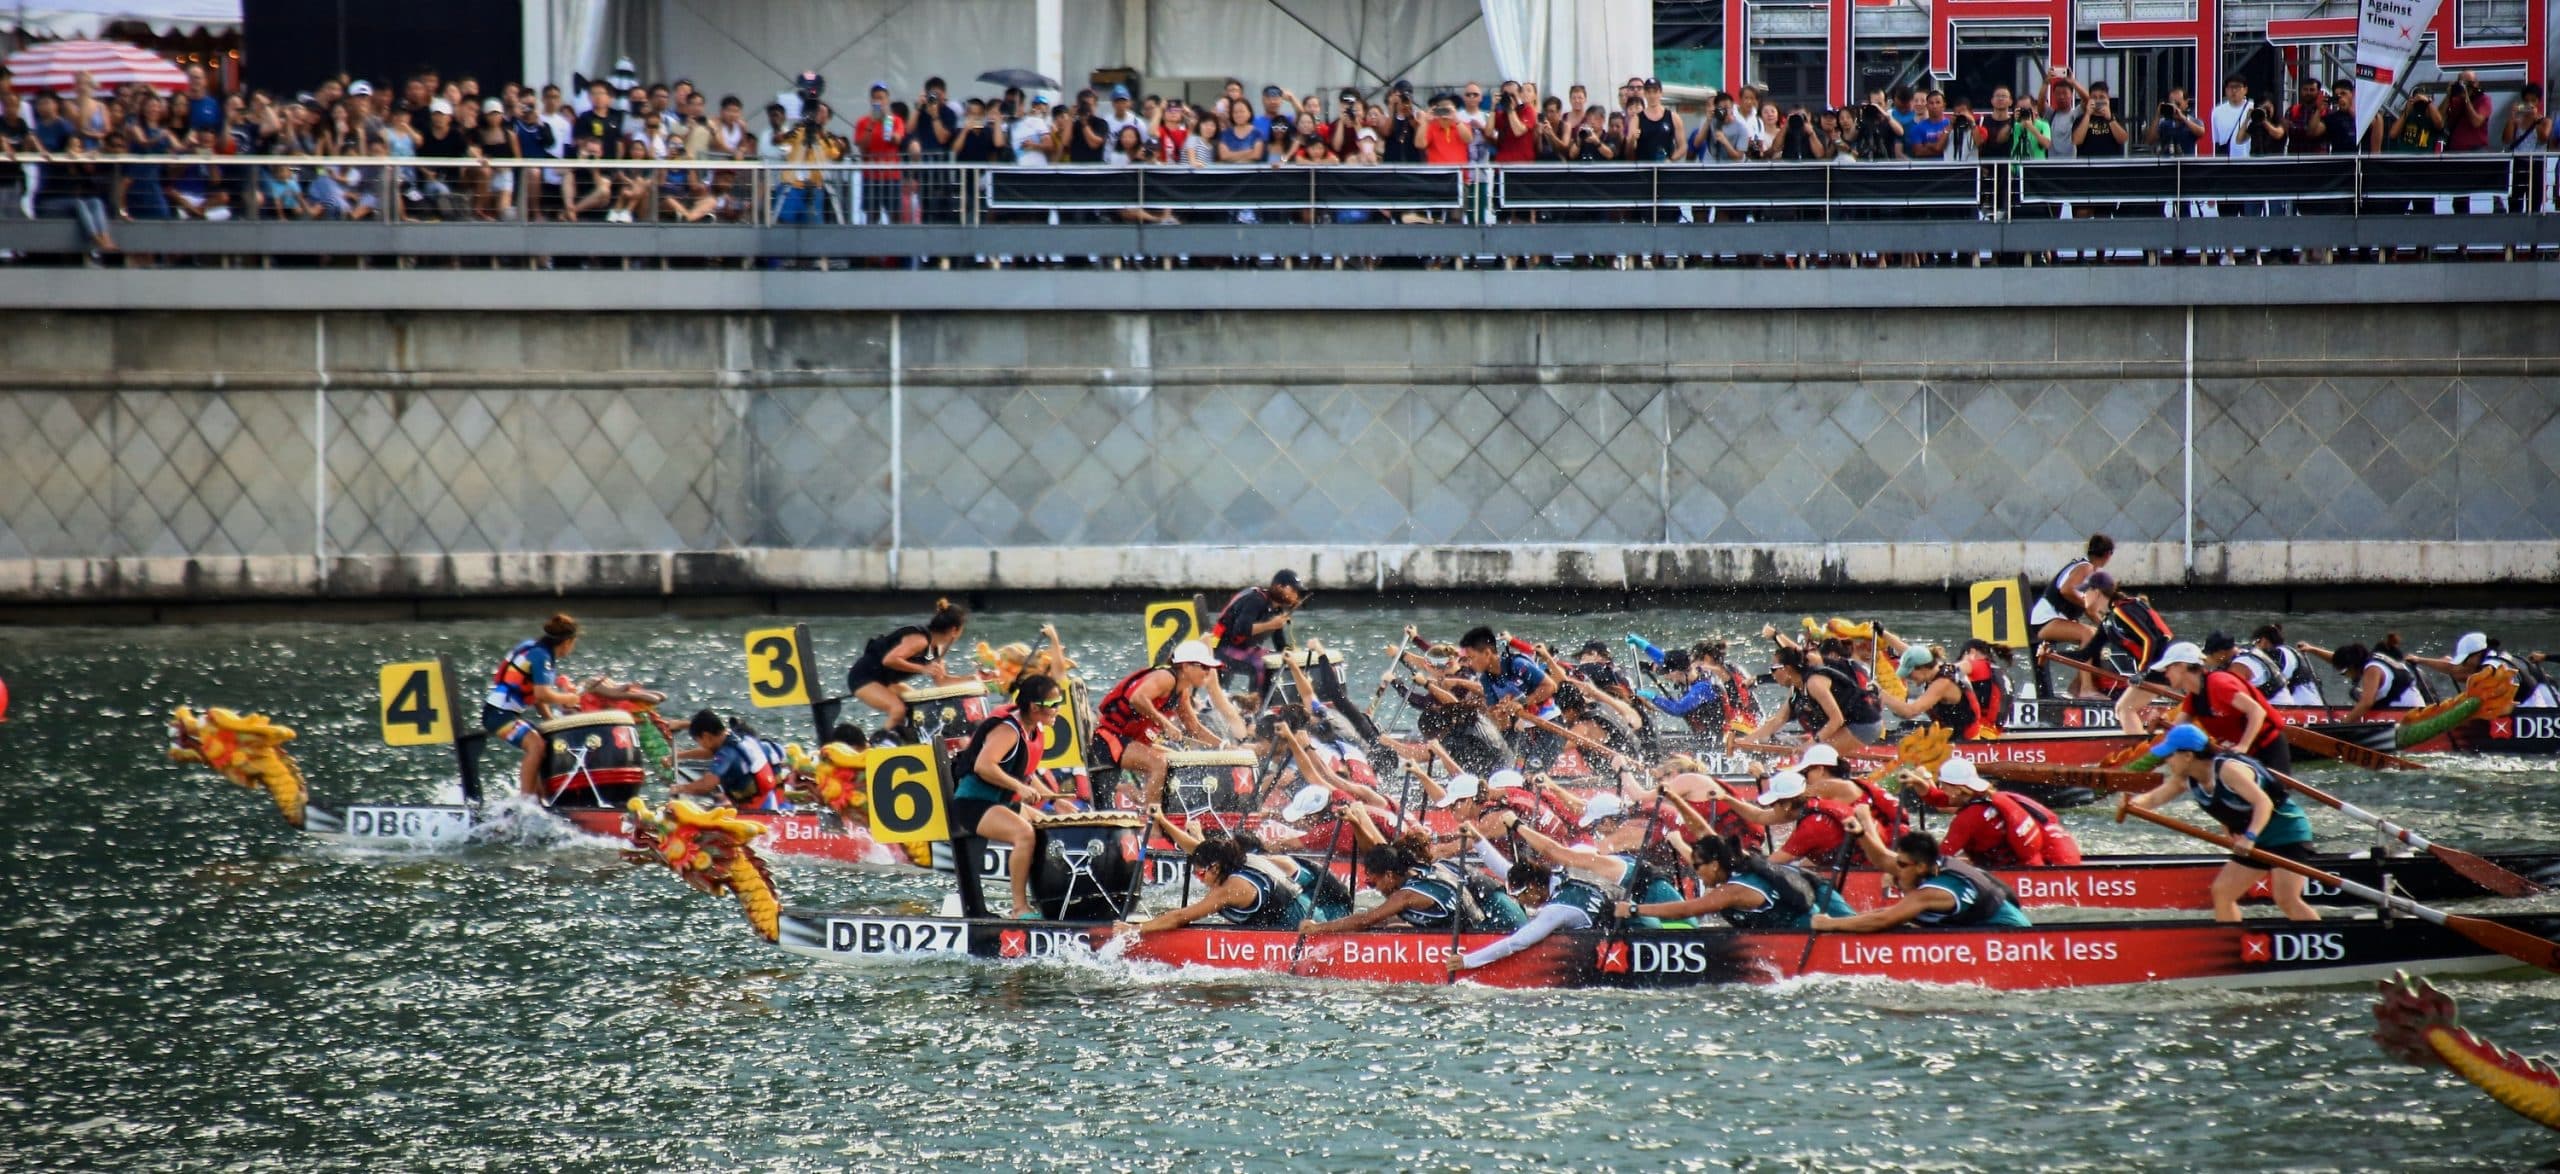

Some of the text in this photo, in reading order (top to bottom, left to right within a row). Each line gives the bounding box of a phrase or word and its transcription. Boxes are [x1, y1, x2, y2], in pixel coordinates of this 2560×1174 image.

[2367, 13, 2395, 28] Time
[2368, 0, 2412, 16] Against
[1977, 587, 2008, 641] 1
[1151, 608, 1192, 667] 2
[751, 636, 799, 698] 3
[386, 669, 438, 735] 4
[2007, 746, 2046, 763] less
[872, 755, 933, 833] 6
[2018, 874, 2137, 898] Bank less
[832, 921, 963, 954] DB027
[1206, 938, 1256, 961] Live
[1344, 941, 1408, 964] Bank
[1417, 940, 1468, 965] less
[1841, 936, 2119, 967] Live more, Bank less
[2273, 933, 2346, 961] DBS
[1632, 941, 1707, 973] DBS
